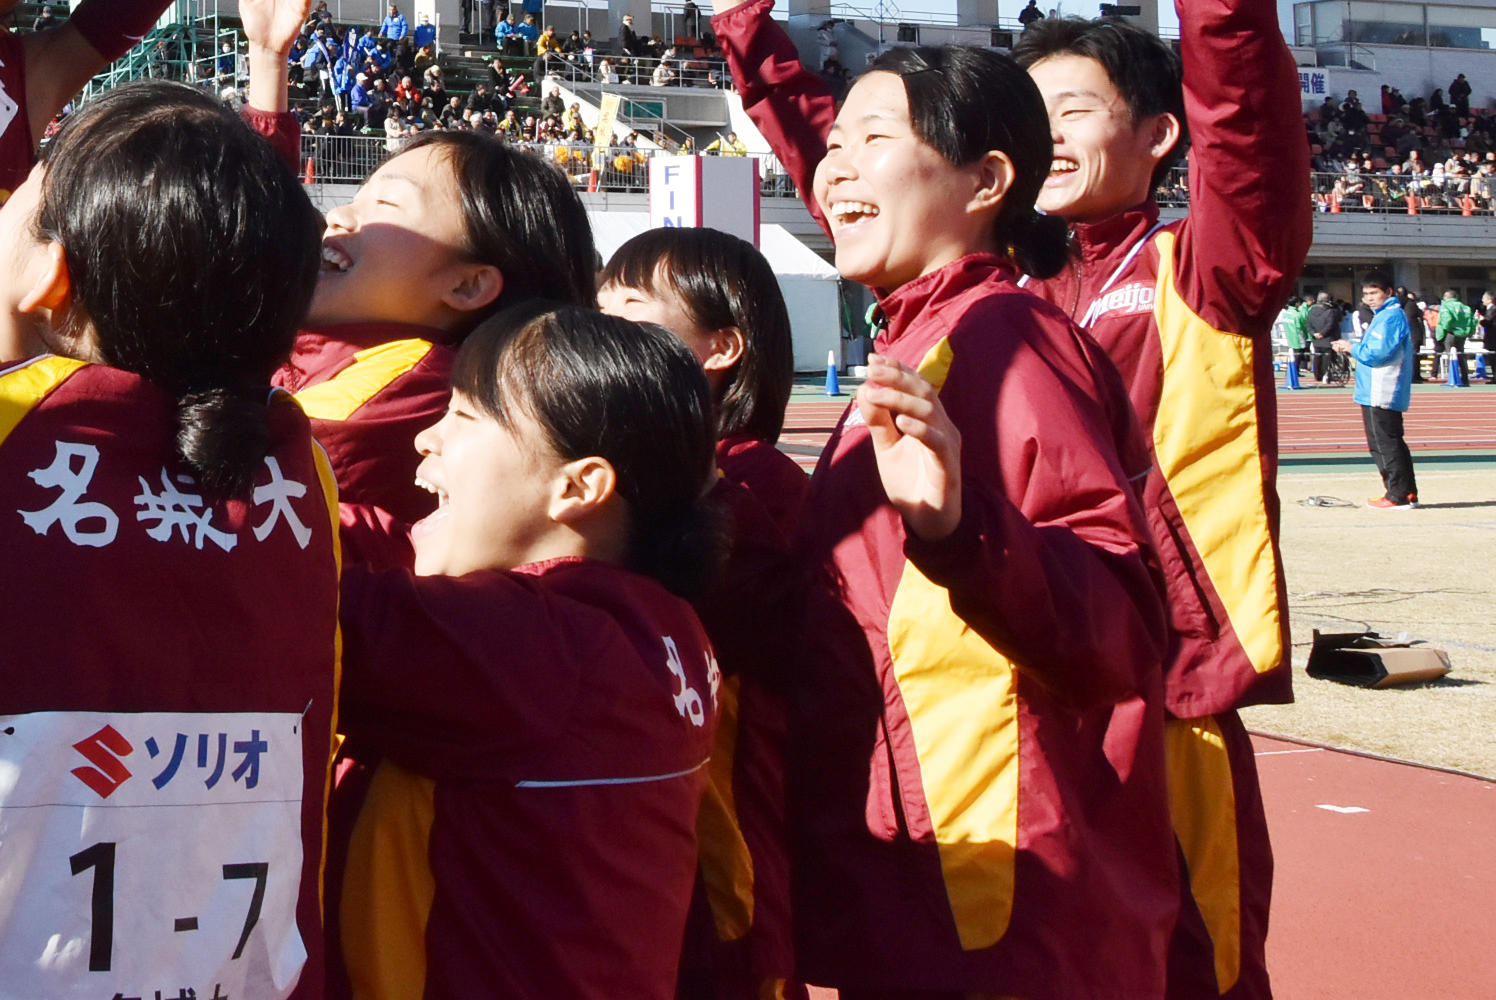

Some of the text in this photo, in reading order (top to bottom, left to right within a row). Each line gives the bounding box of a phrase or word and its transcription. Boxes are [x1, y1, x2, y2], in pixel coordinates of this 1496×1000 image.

[16, 440, 312, 553] 名城大
[145, 729, 268, 790] ソリオ
